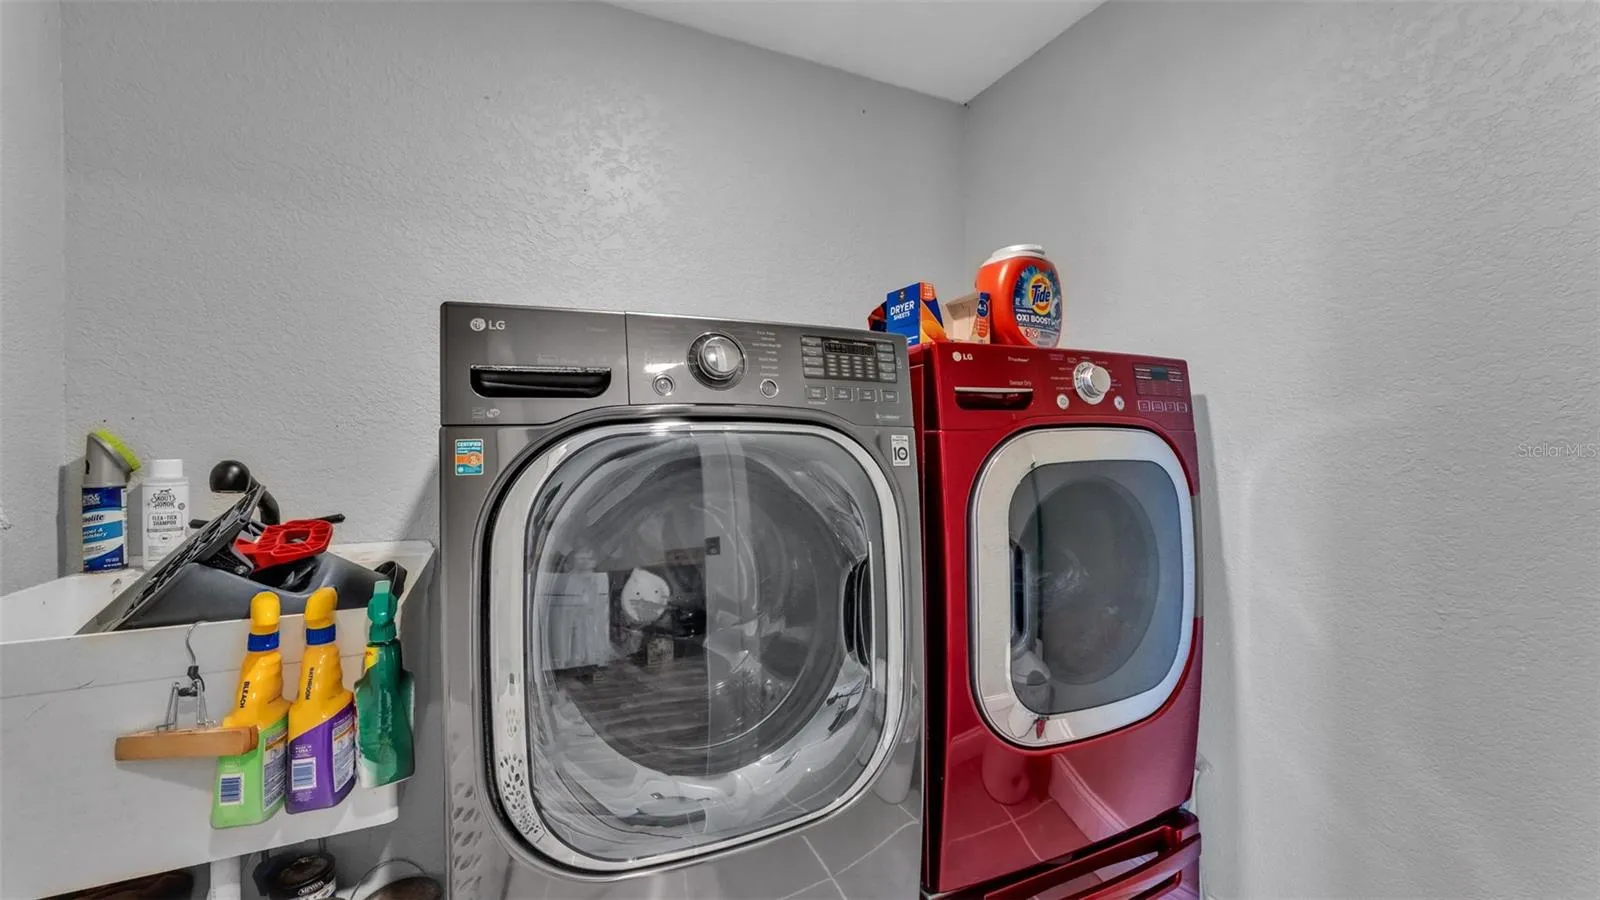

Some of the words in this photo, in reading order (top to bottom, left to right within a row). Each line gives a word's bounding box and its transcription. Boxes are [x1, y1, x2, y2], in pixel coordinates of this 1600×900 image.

[1031, 284, 1051, 305] Tide
[890, 301, 915, 317] DRYER
[893, 311, 911, 321] SHEETS
[488, 320, 506, 331] LG
[1016, 313, 1030, 322] OXI
[1030, 315, 1051, 324] BOOST
[305, 667, 315, 700] BATHROOM
[240, 681, 250, 708] BLEACH
